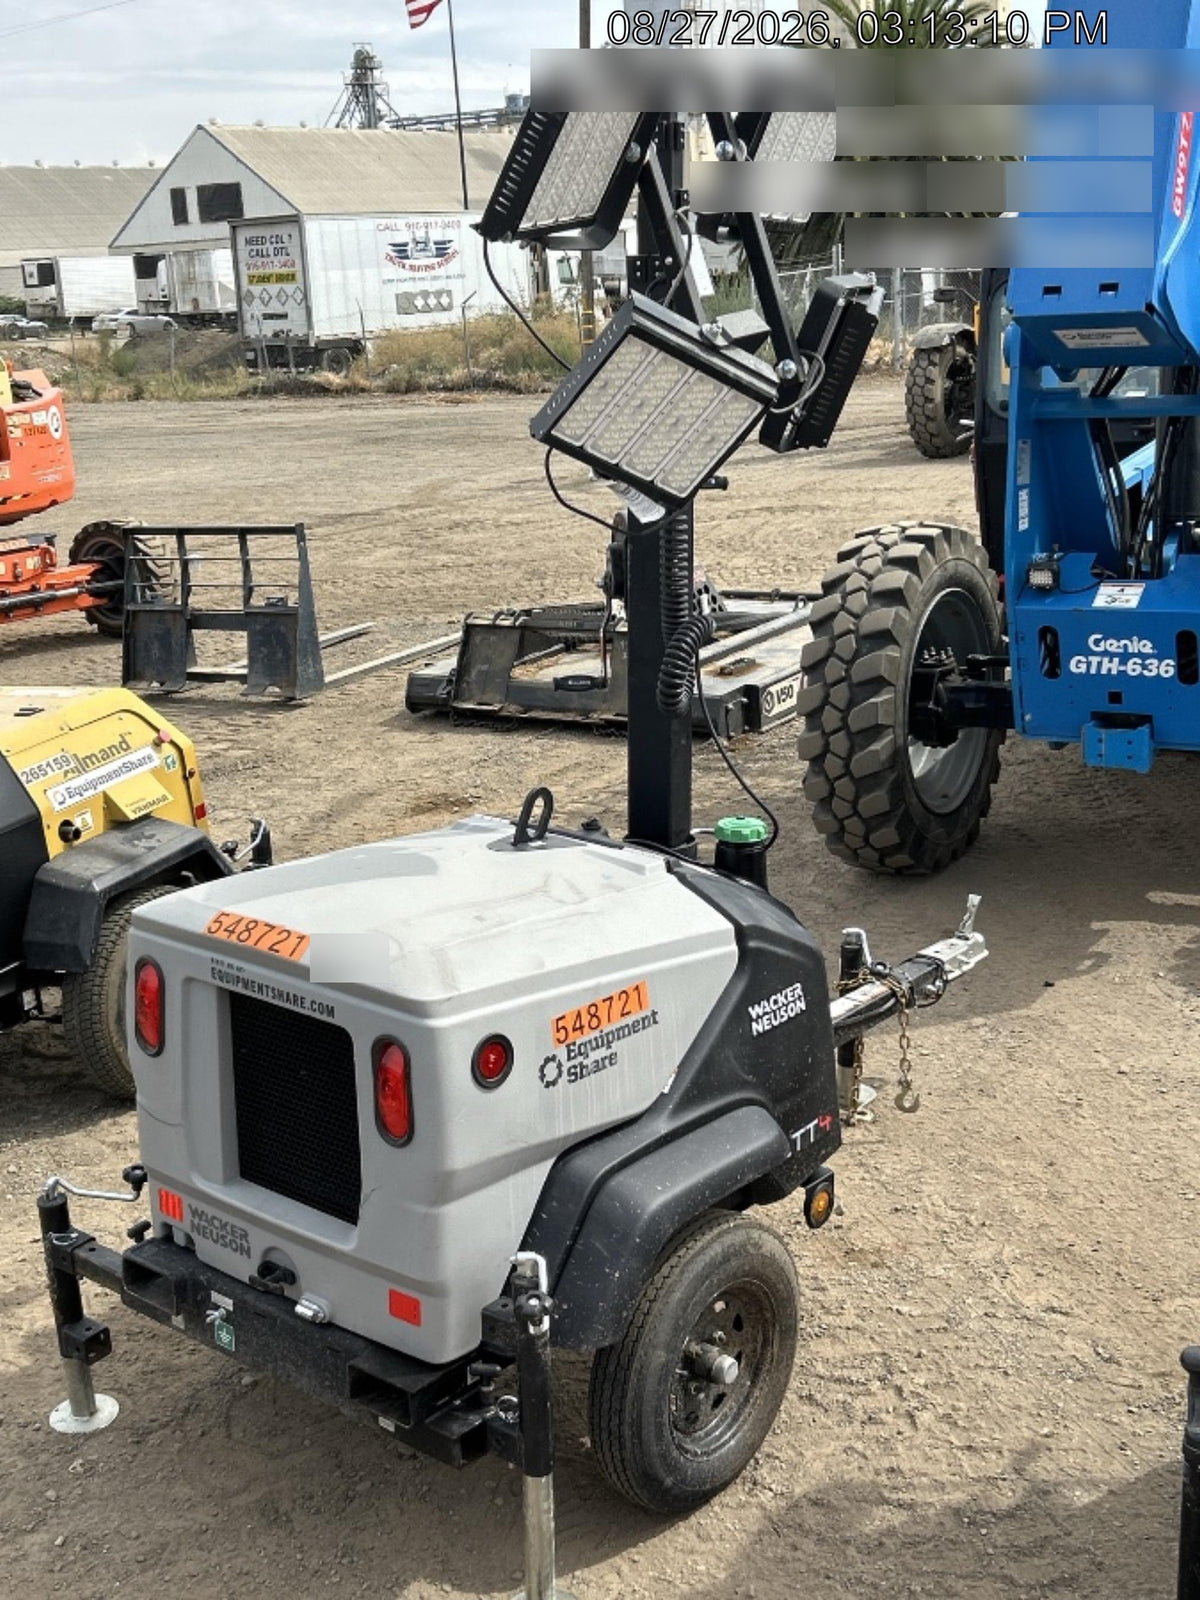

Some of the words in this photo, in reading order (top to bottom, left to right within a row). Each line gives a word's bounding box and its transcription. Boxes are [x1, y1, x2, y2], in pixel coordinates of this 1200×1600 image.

[244, 236, 267, 246] NEED
[248, 248, 271, 258] CALL
[1088, 634, 1153, 653] Genie
[1069, 656, 1176, 677] GTH-636
[21, 754, 71, 785] 265159
[66, 753, 154, 799] EquipmentShare
[207, 912, 307, 957] 548721
[210, 966, 335, 1019] EQUIPMENTSHARE.COM
[748, 983, 803, 1020] WACKER
[555, 984, 643, 1045] 548721
[752, 997, 806, 1036] NEUSON
[565, 1009, 659, 1062] Equipment
[566, 1051, 618, 1083] Share
[188, 1203, 250, 1243] WACKER
[190, 1219, 252, 1259] NEUSON
